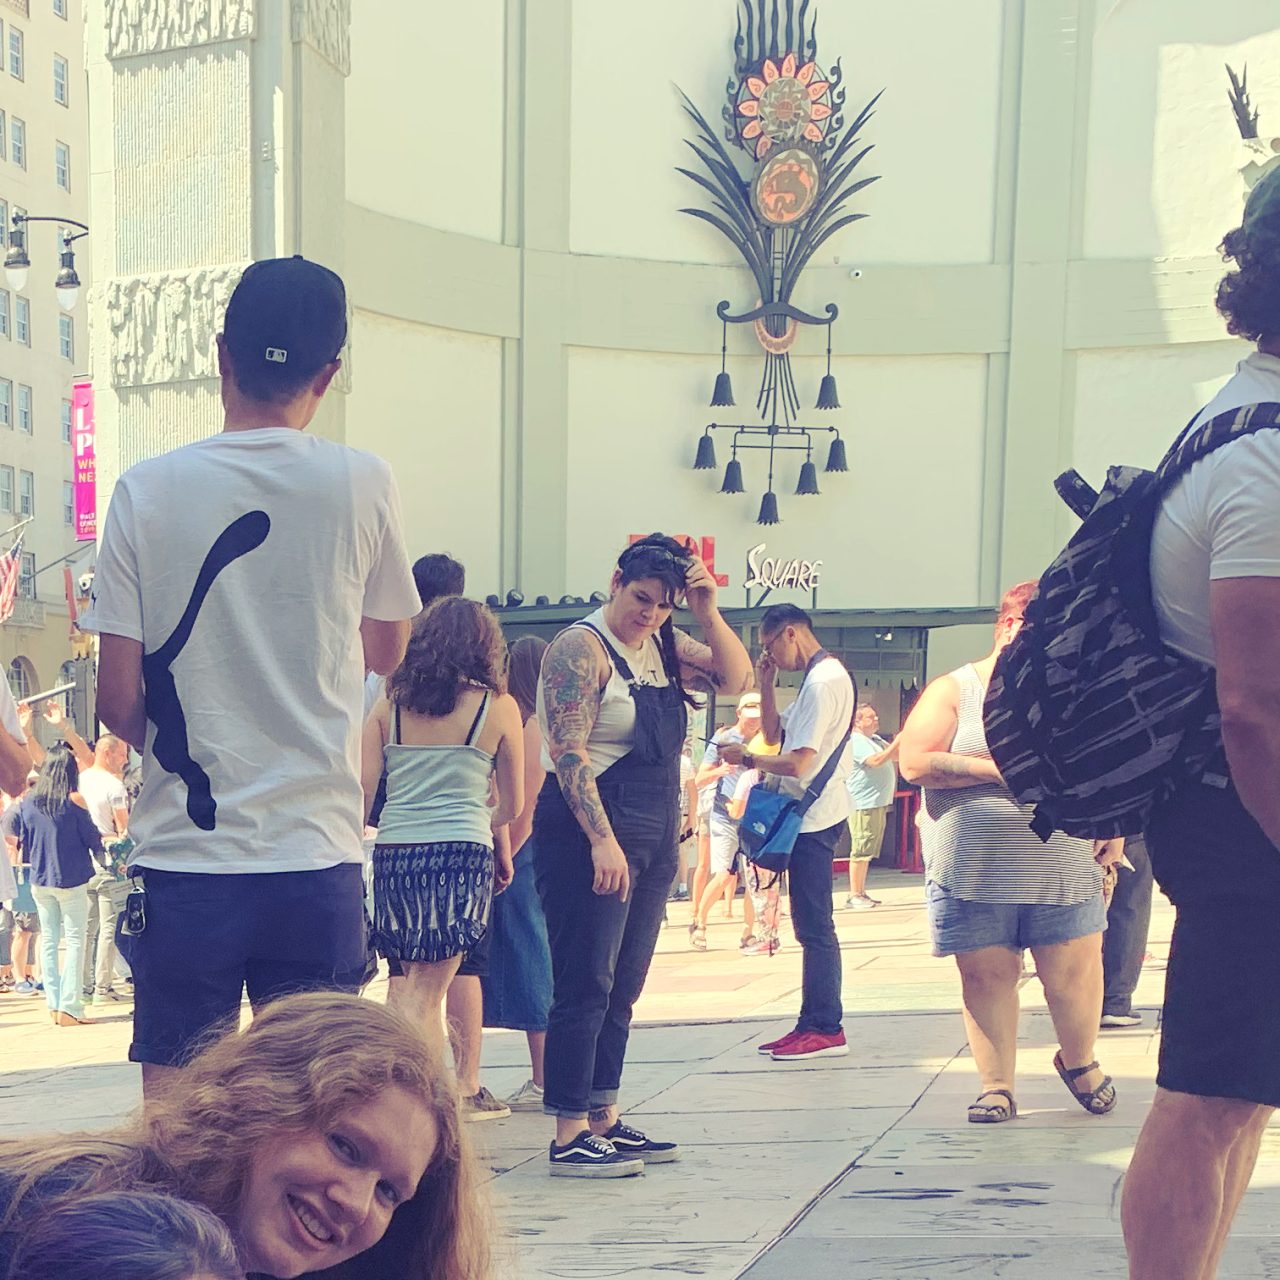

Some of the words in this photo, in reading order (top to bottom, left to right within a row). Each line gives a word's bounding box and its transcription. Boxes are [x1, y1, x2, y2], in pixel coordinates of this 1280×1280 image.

[76, 432, 96, 456] P
[78, 472, 96, 483] NE
[743, 543, 823, 592] SQUARE
